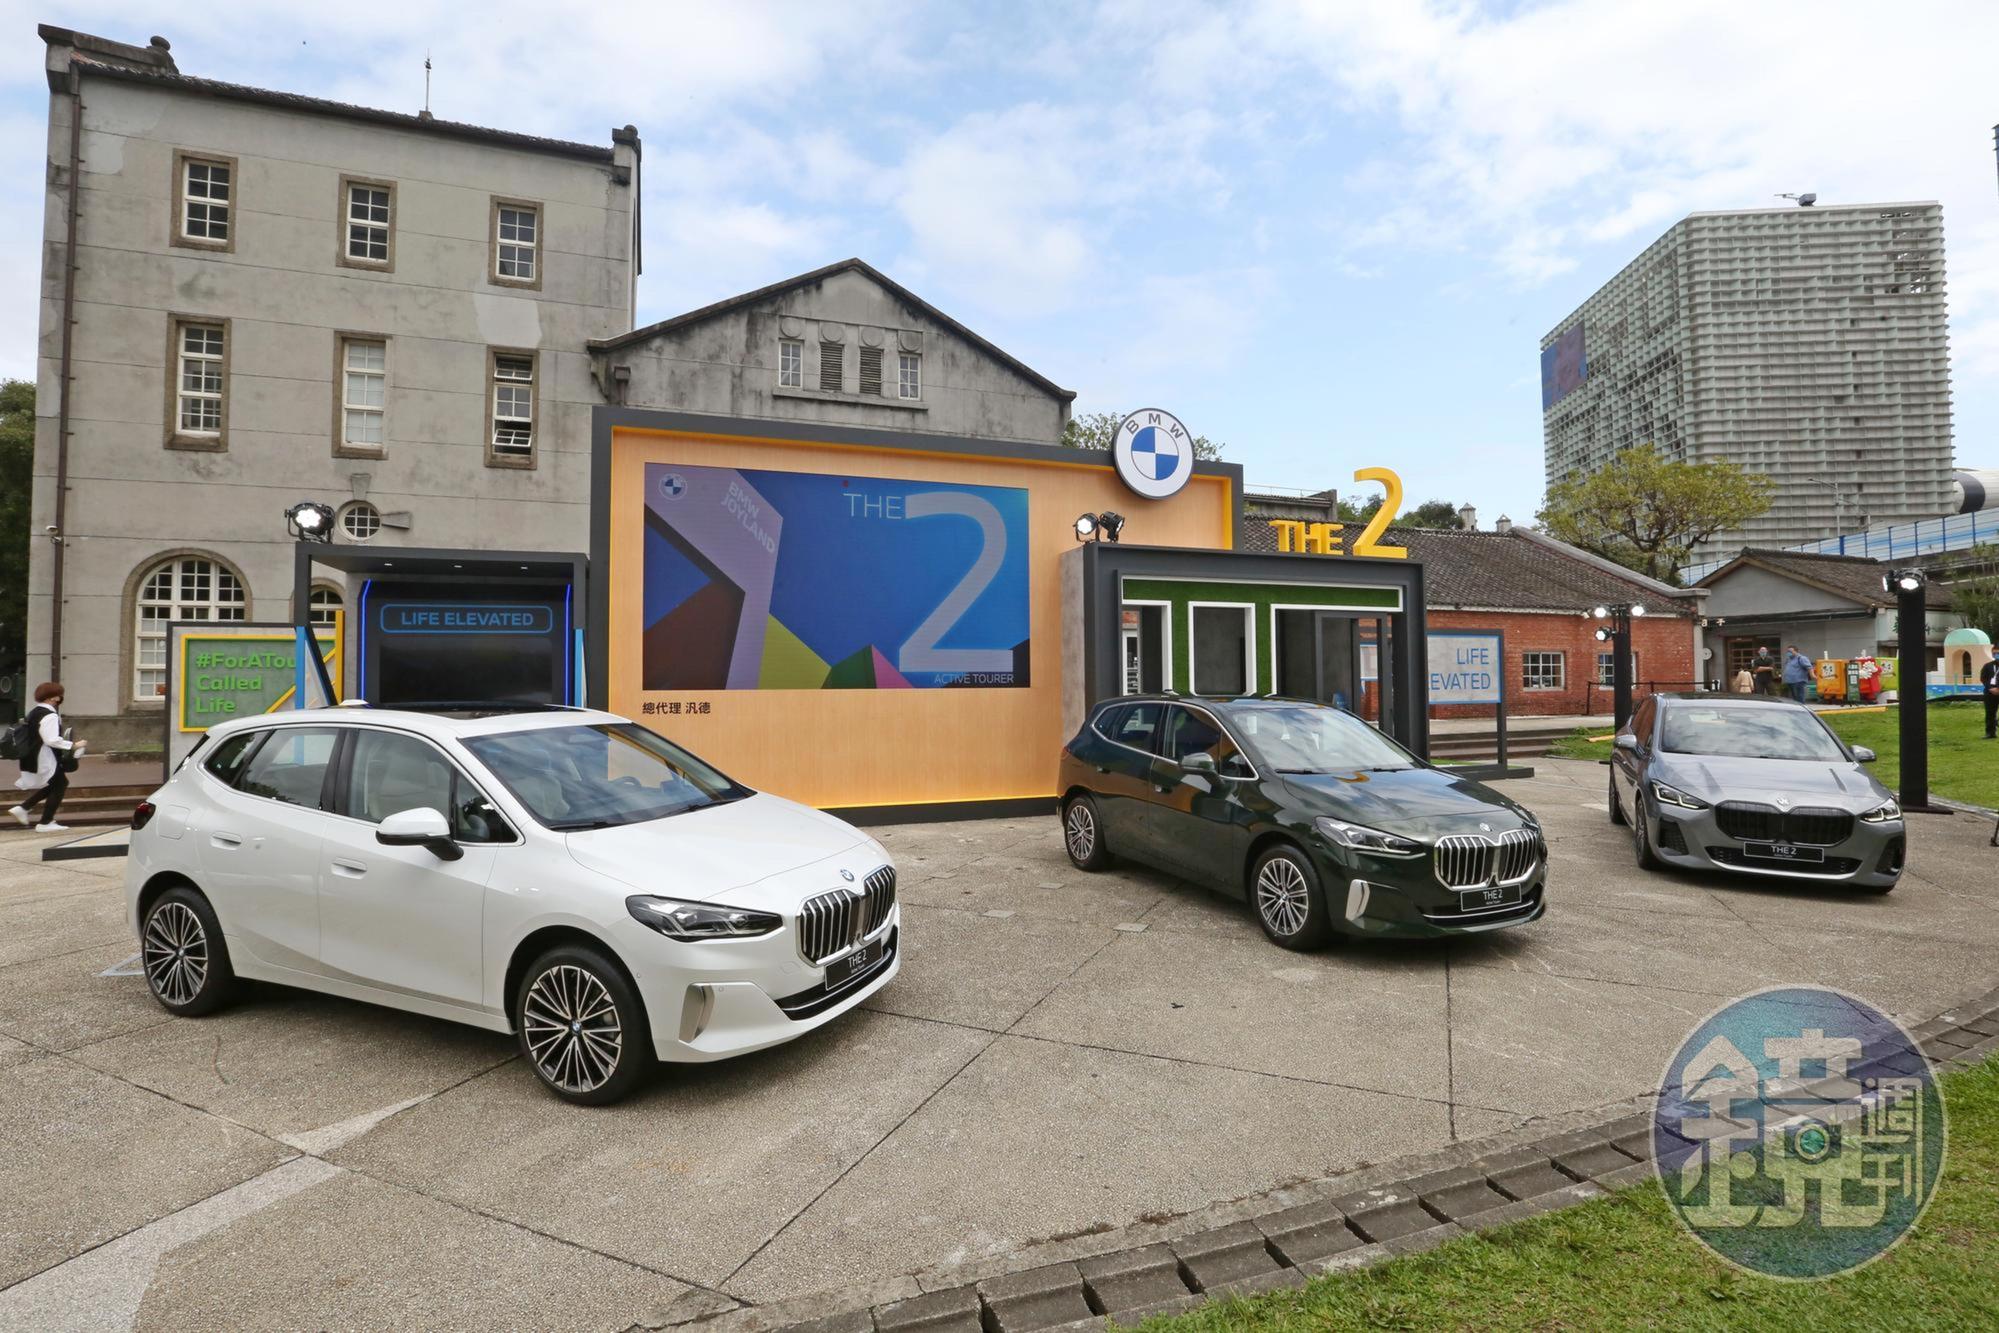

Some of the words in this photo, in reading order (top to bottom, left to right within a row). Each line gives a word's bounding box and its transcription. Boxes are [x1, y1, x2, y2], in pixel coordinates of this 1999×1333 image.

[1125, 412, 1184, 439] BMW
[728, 481, 760, 520] BMW
[1267, 519, 1344, 556] THE
[1353, 466, 1408, 559] 2
[720, 493, 776, 554] JOYLAND
[843, 492, 903, 520] THE
[899, 491, 1014, 673] 2
[401, 612, 439, 625] LIFE
[444, 612, 534, 626] ELEVATED
[1457, 647, 1490, 665] LIFE
[197, 674, 263, 691] Called
[934, 673, 971, 684] ACTIVE
[972, 673, 1014, 684] TOURER
[1428, 672, 1491, 690] EVATED
[195, 696, 236, 713] Life
[642, 702, 682, 715] 總代理
[685, 702, 711, 714] 汎德
[1771, 845, 1790, 855] THE
[1483, 890, 1498, 901] THE
[848, 951, 862, 968] THE
